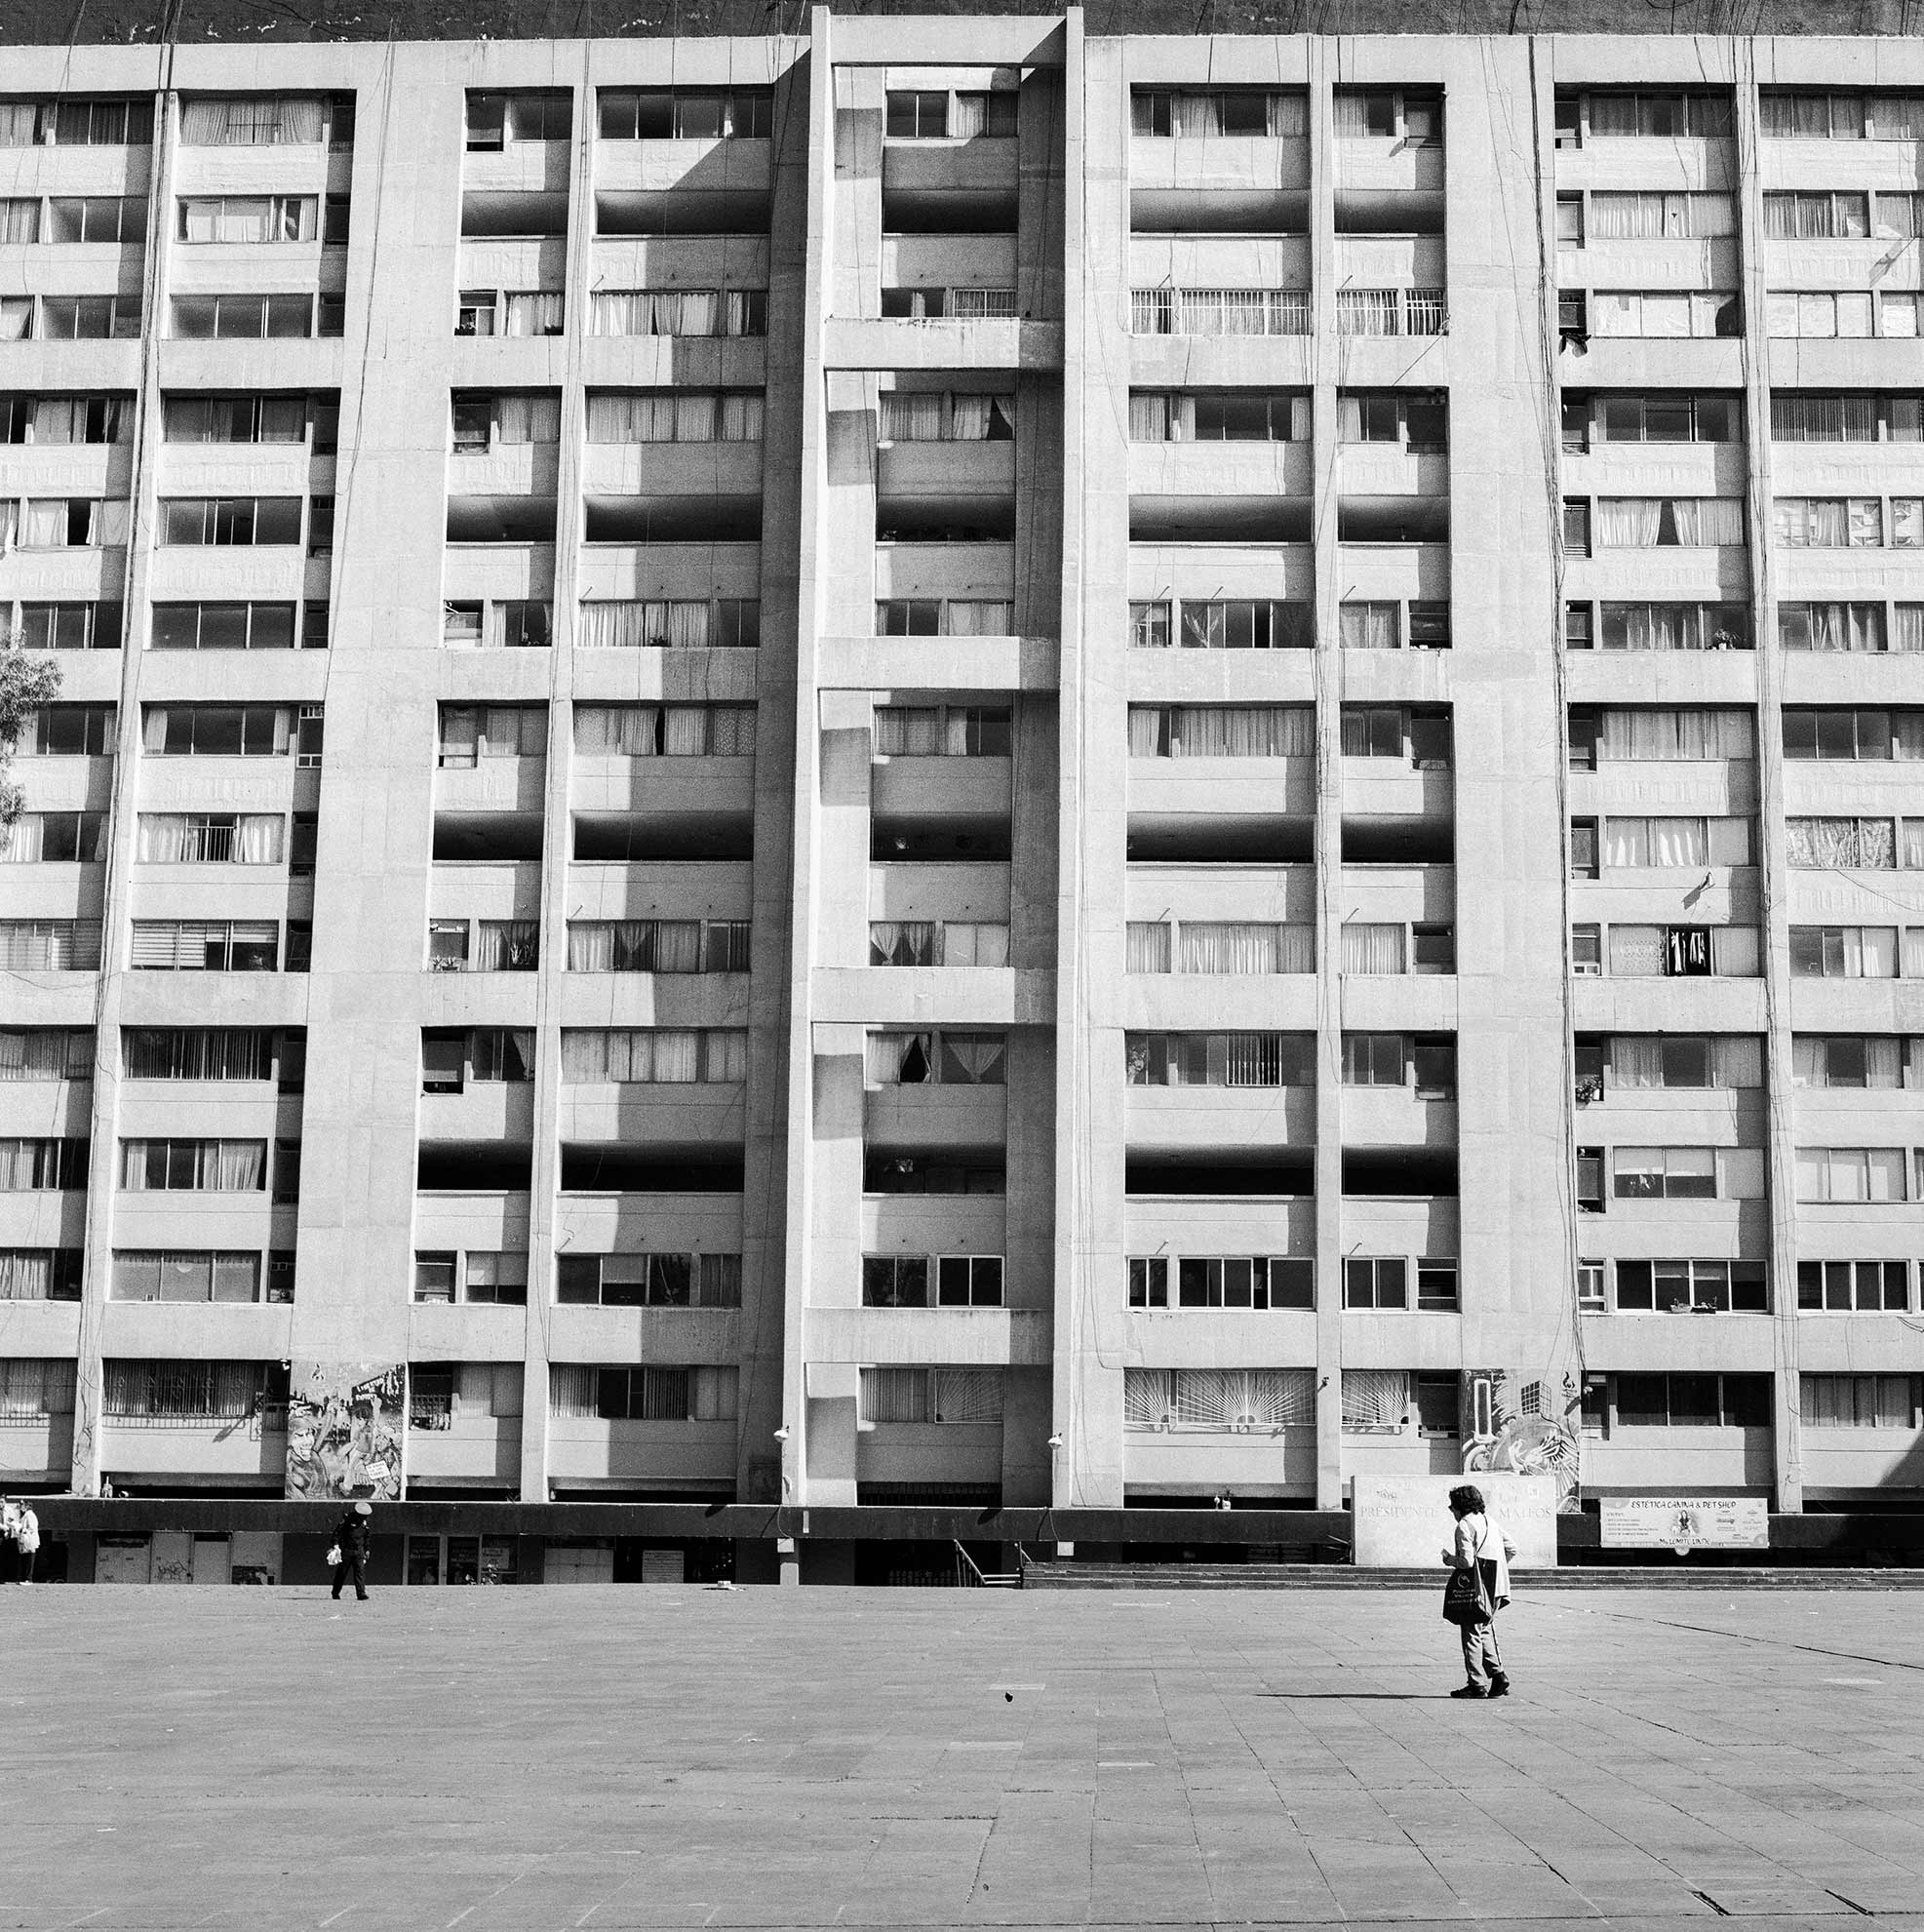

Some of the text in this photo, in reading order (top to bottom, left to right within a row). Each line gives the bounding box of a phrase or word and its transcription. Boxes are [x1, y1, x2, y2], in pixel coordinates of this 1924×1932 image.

[1668, 1500, 1695, 1509] CANINA
[1703, 1500, 1717, 1509] PET
[1718, 1500, 1737, 1509] SHOP
[1360, 1506, 1437, 1518] PRESIDENTE
